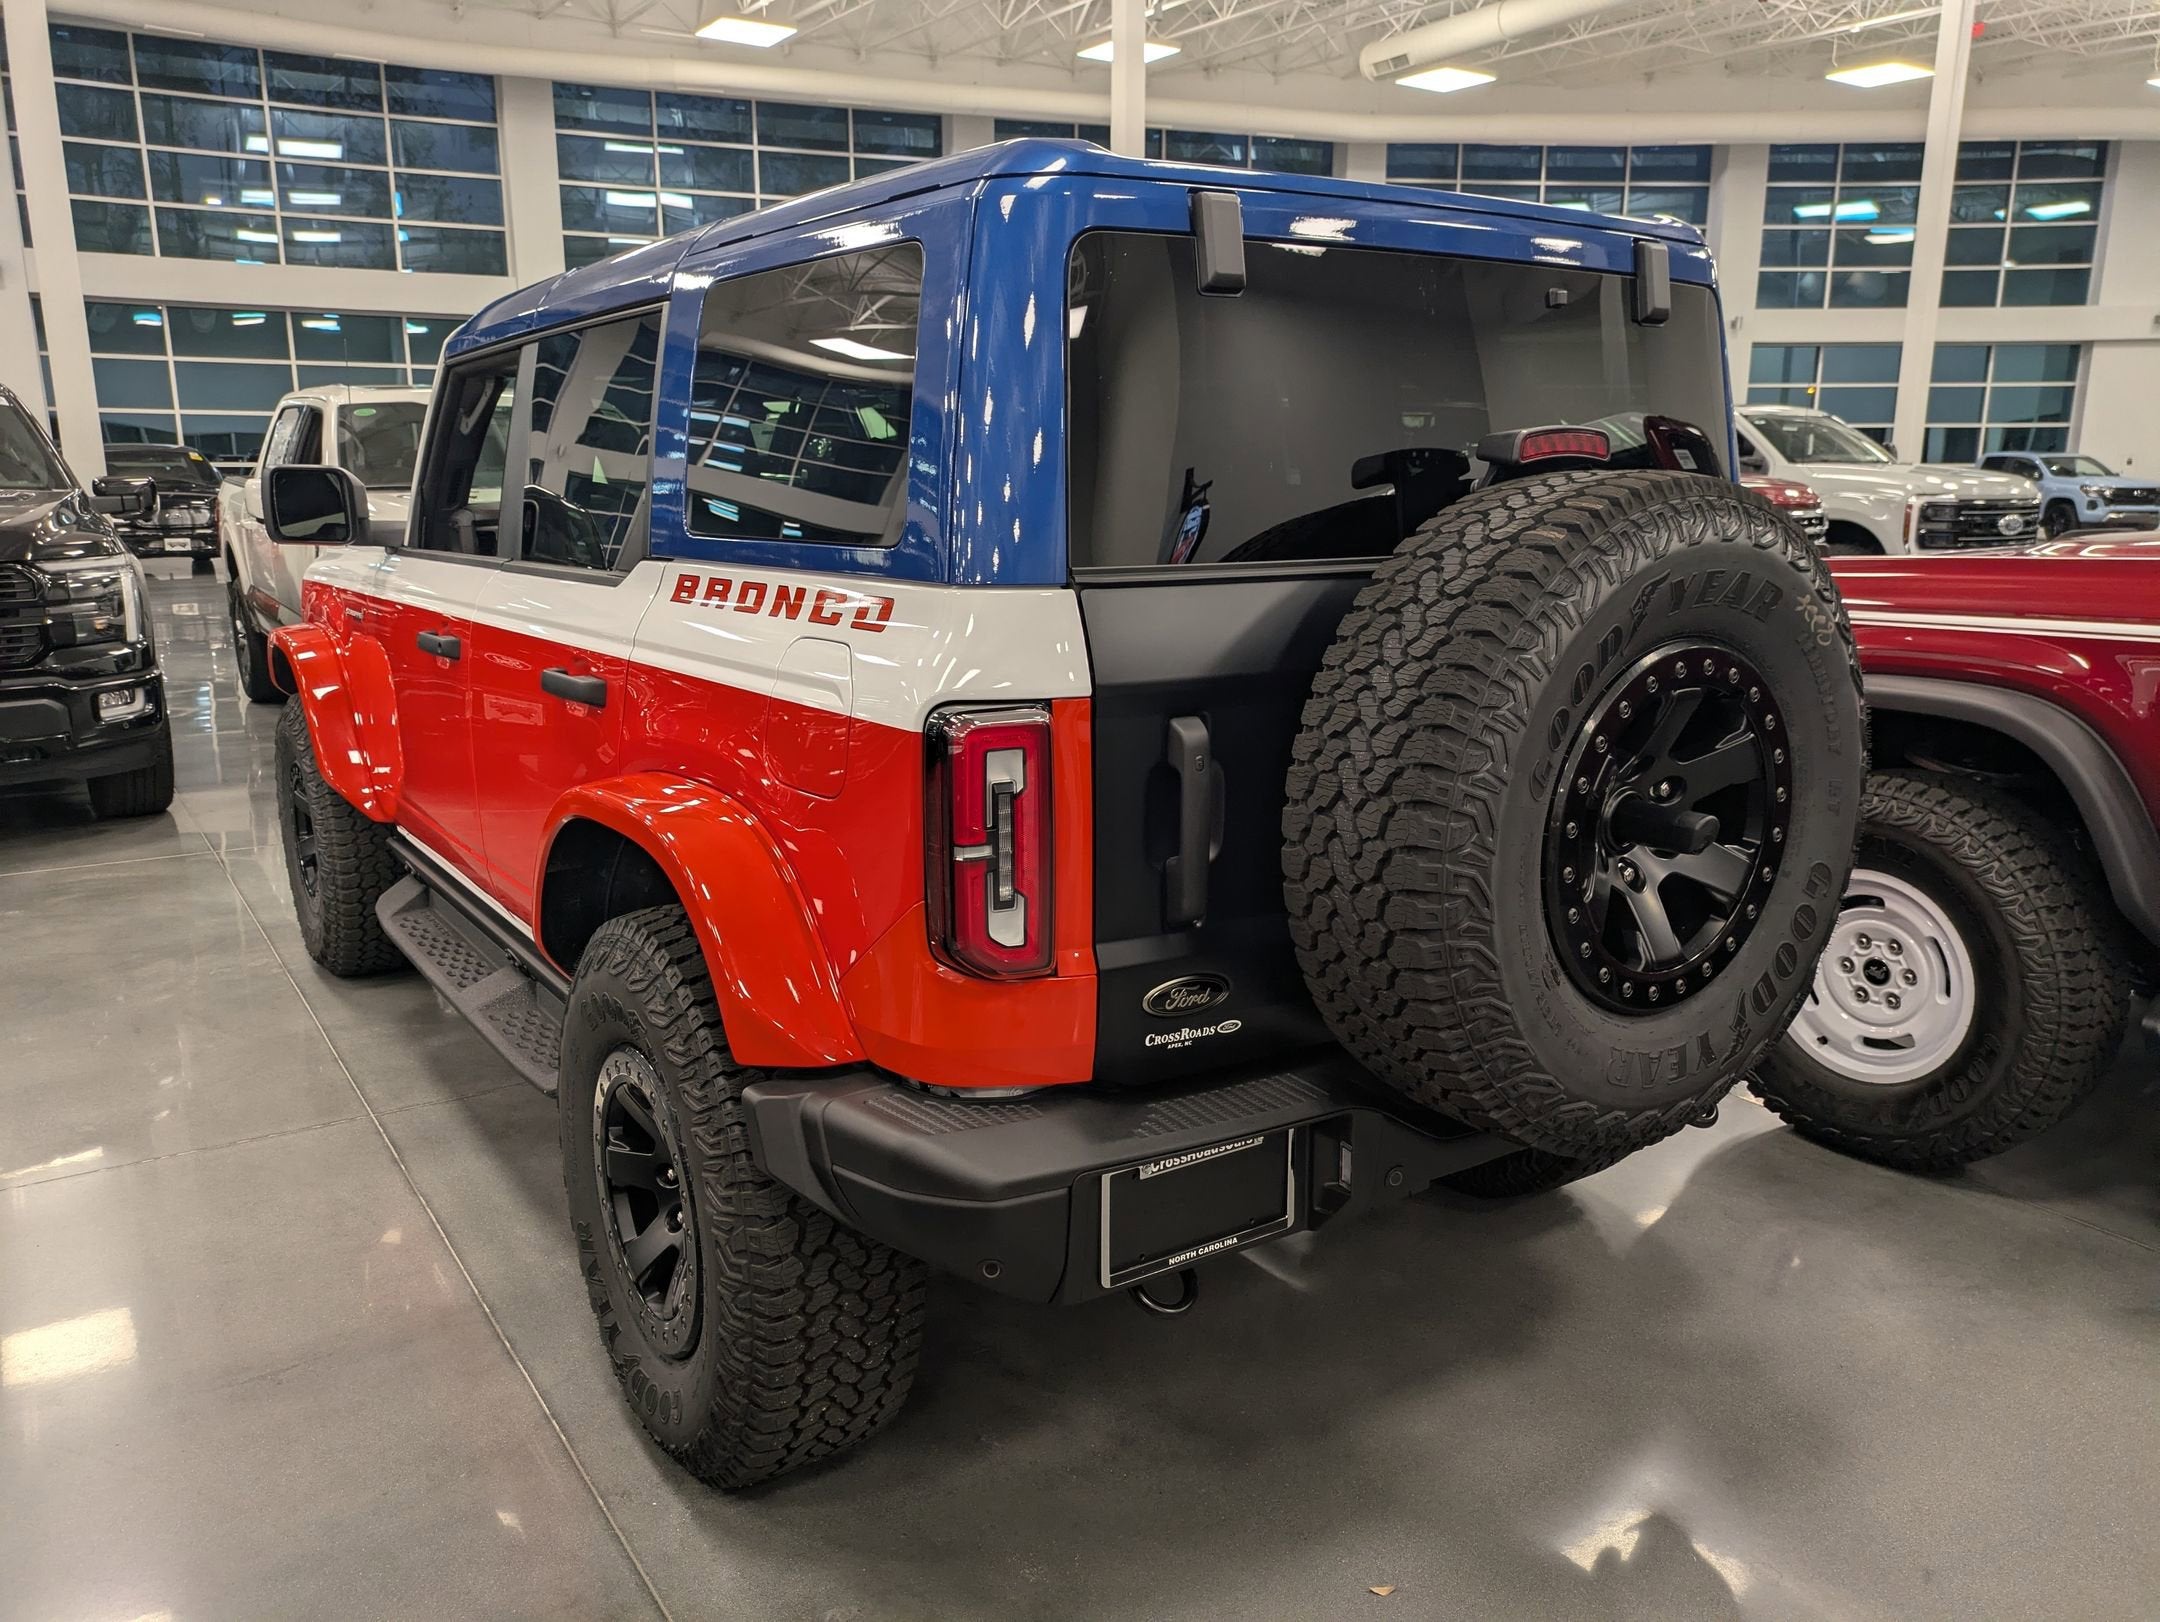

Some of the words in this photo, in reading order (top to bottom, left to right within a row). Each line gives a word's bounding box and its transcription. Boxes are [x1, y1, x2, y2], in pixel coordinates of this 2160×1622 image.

[670, 573, 895, 633] BRONCO
[1606, 862, 1833, 1088] GOODYEAR
[1165, 985, 1211, 1010] Ford
[1168, 1251, 1197, 1265] NORTH
[1198, 1237, 1238, 1255] CAROLINA
